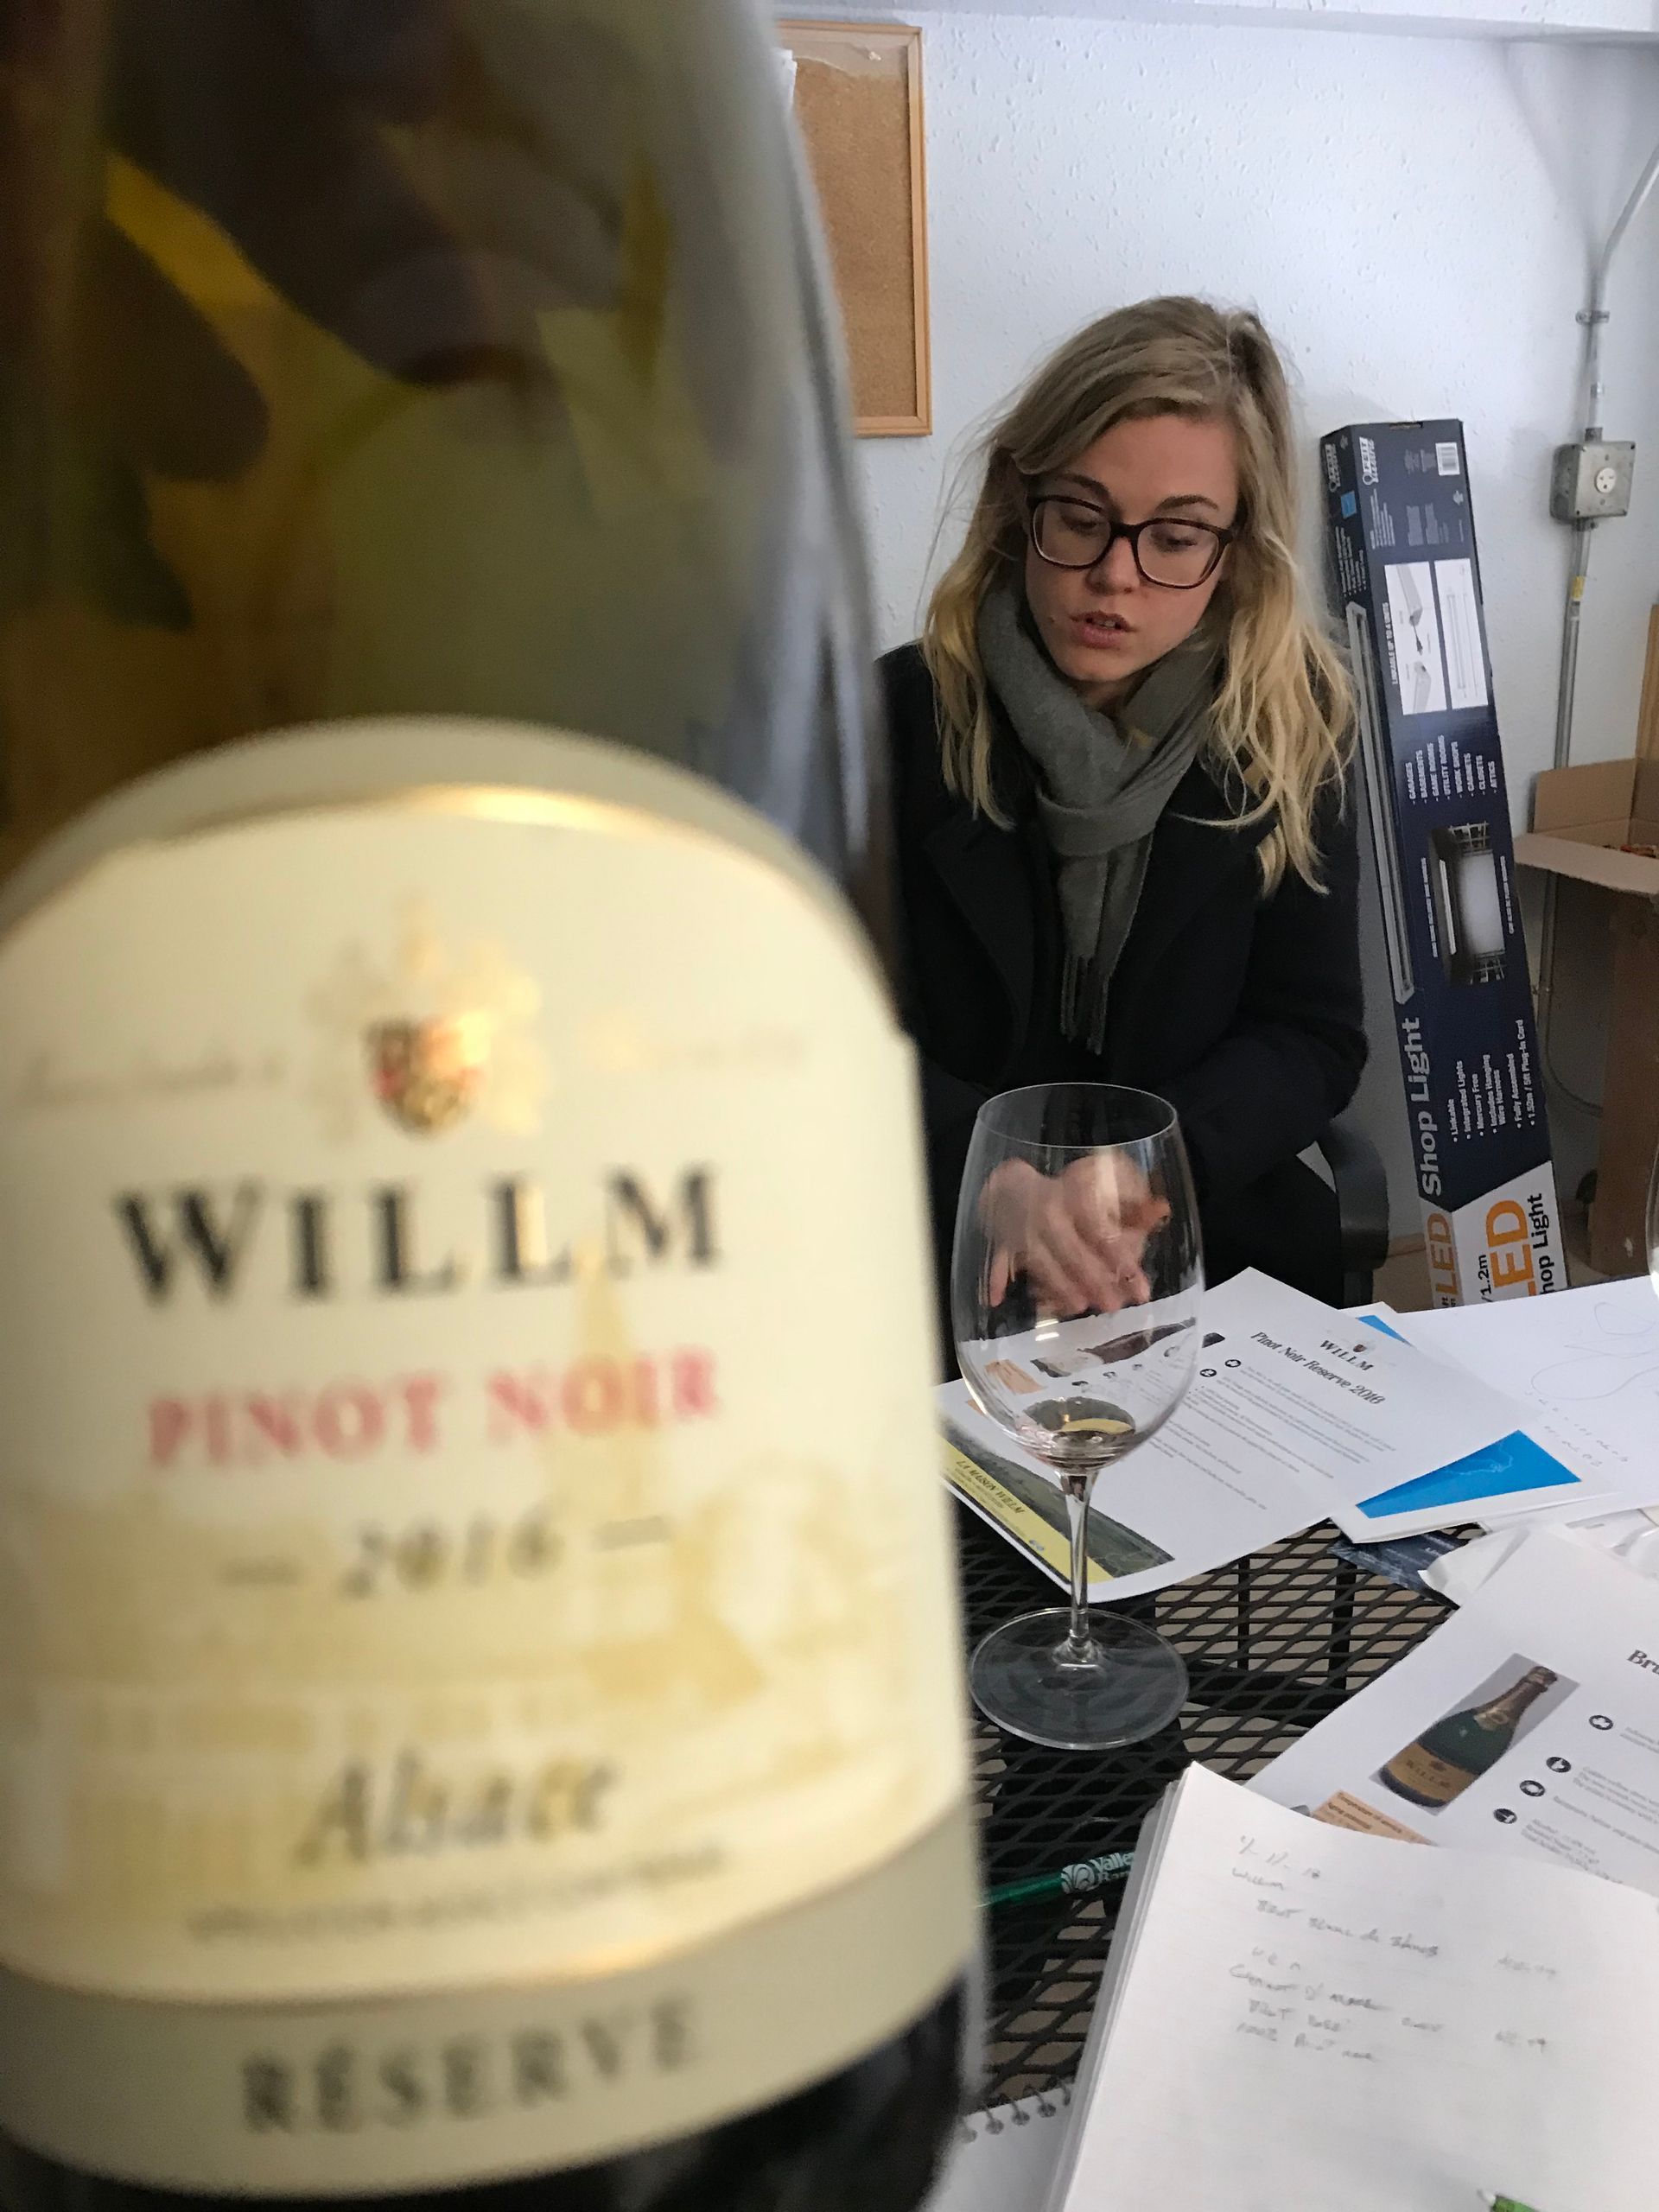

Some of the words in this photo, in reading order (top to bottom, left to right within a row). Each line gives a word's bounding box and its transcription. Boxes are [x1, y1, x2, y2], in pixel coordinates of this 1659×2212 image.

[1405, 762, 1416, 799] GARAGES
[1416, 750, 1427, 798] BASEMENTS
[1488, 761, 1497, 788] ATTICS
[1516, 1020, 1525, 1039] Cord
[1402, 1016, 1431, 1103] Light
[1456, 1060, 1466, 1089] Lights
[1483, 1054, 1492, 1089] Hanging
[1506, 1053, 1519, 1099] Assembled
[1494, 1069, 1503, 1103] Harness
[1448, 1098, 1459, 1135] Linkable
[1459, 1090, 1471, 1133] Integrated
[1474, 1095, 1485, 1130] Mercury
[1486, 1090, 1498, 1127] Includes
[1497, 1104, 1506, 1125] Wire
[1513, 1100, 1523, 1122] Fully
[1418, 1111, 1442, 1197] Shop
[114, 1161, 727, 1312] WILLM
[1527, 1193, 1549, 1249] Light
[1427, 1212, 1458, 1294] LED
[1537, 1255, 1554, 1294] hop
[1250, 1332, 1282, 1350] Pinot
[1278, 1346, 1306, 1362] Noir
[1303, 1359, 1352, 1389] Reserve
[1349, 1383, 1386, 1404] 2016
[1319, 1339, 1375, 1371] WILLM
[147, 1374, 442, 1471] PINOT
[484, 1345, 722, 1441] NOIR
[335, 1505, 570, 1602] 2016
[295, 1747, 620, 1871] Alsace
[240, 1999, 702, 2138] RÉSERVE
